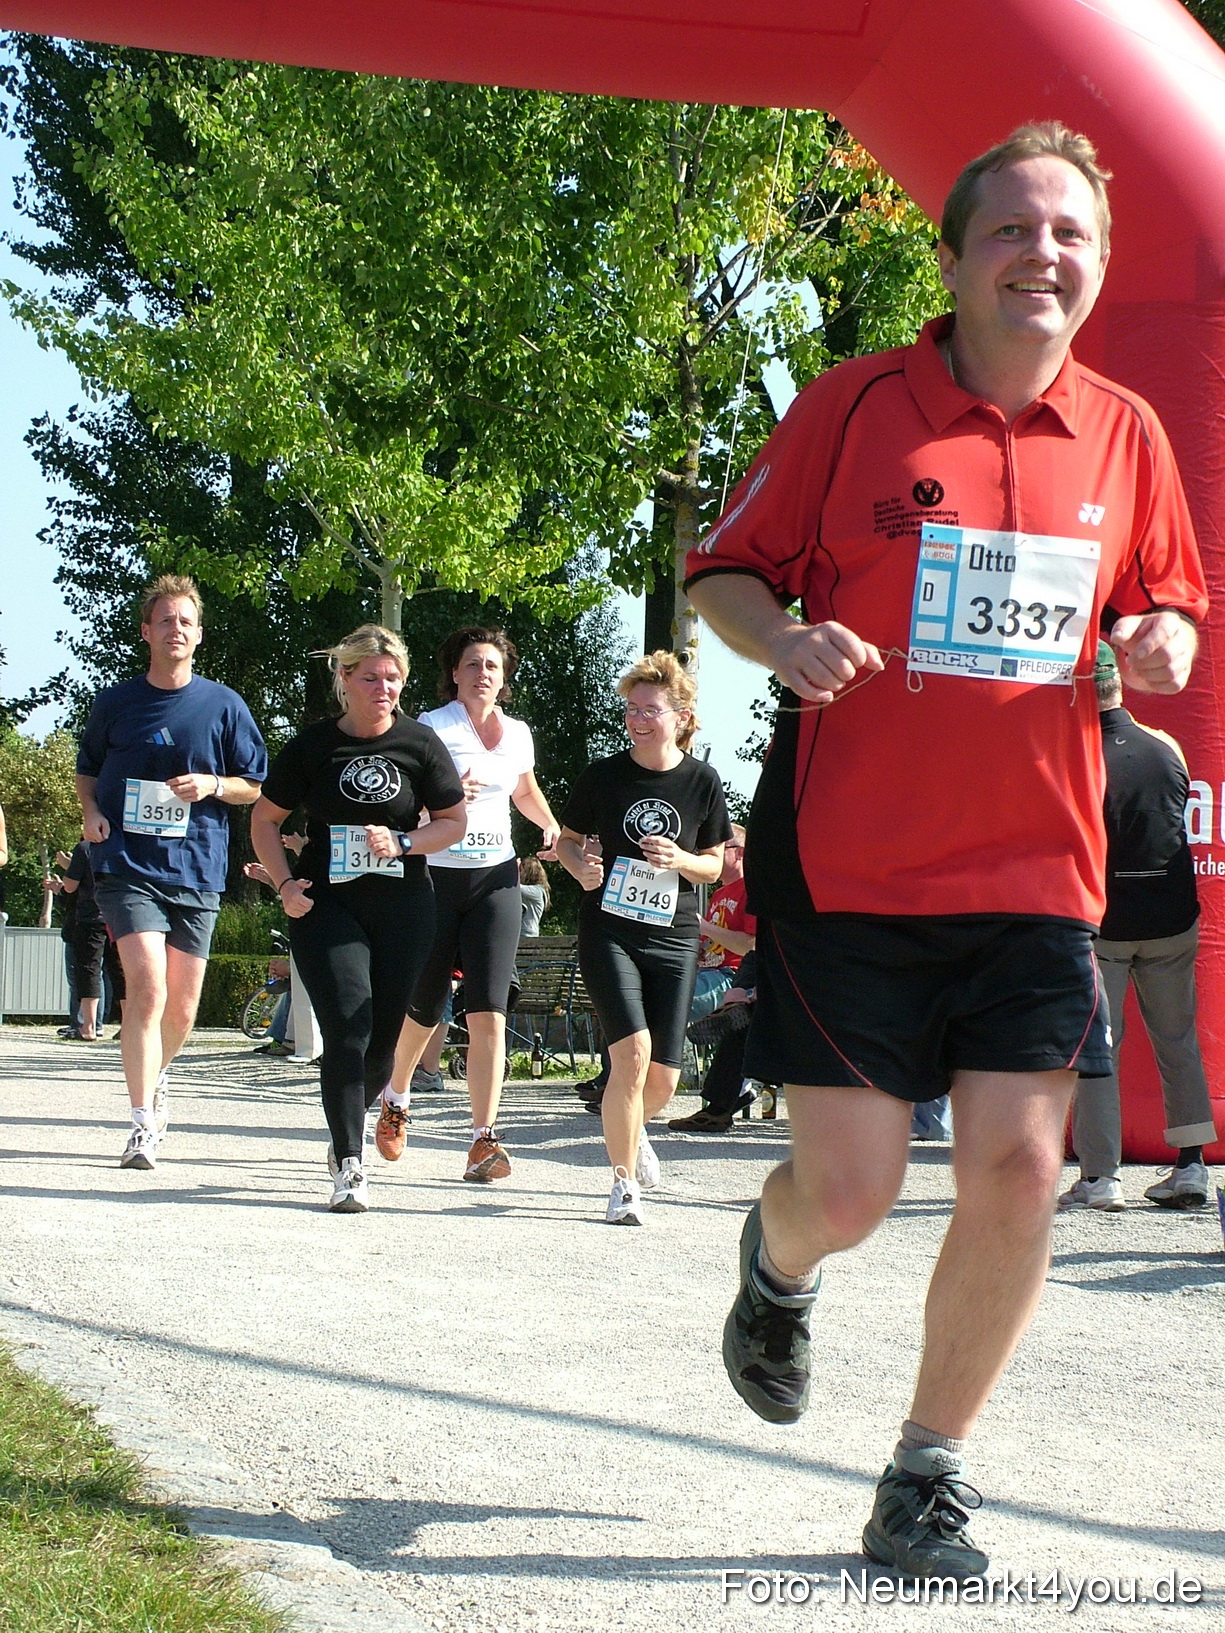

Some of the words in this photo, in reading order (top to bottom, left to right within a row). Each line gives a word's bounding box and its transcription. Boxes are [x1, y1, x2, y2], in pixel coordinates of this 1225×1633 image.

[874, 509, 959, 525] Vermögensberatung
[874, 519, 922, 534] Christian
[969, 543, 1017, 573] Otto
[922, 582, 935, 602] D
[967, 596, 1077, 642] 3337
[911, 649, 979, 668] BOCK
[1019, 659, 1073, 676] PFLEIDERER
[143, 804, 185, 822] 3519
[467, 832, 503, 846] 3520
[630, 864, 655, 881] Karin
[626, 886, 671, 910] 3149
[935, 1453, 962, 1468] adidas
